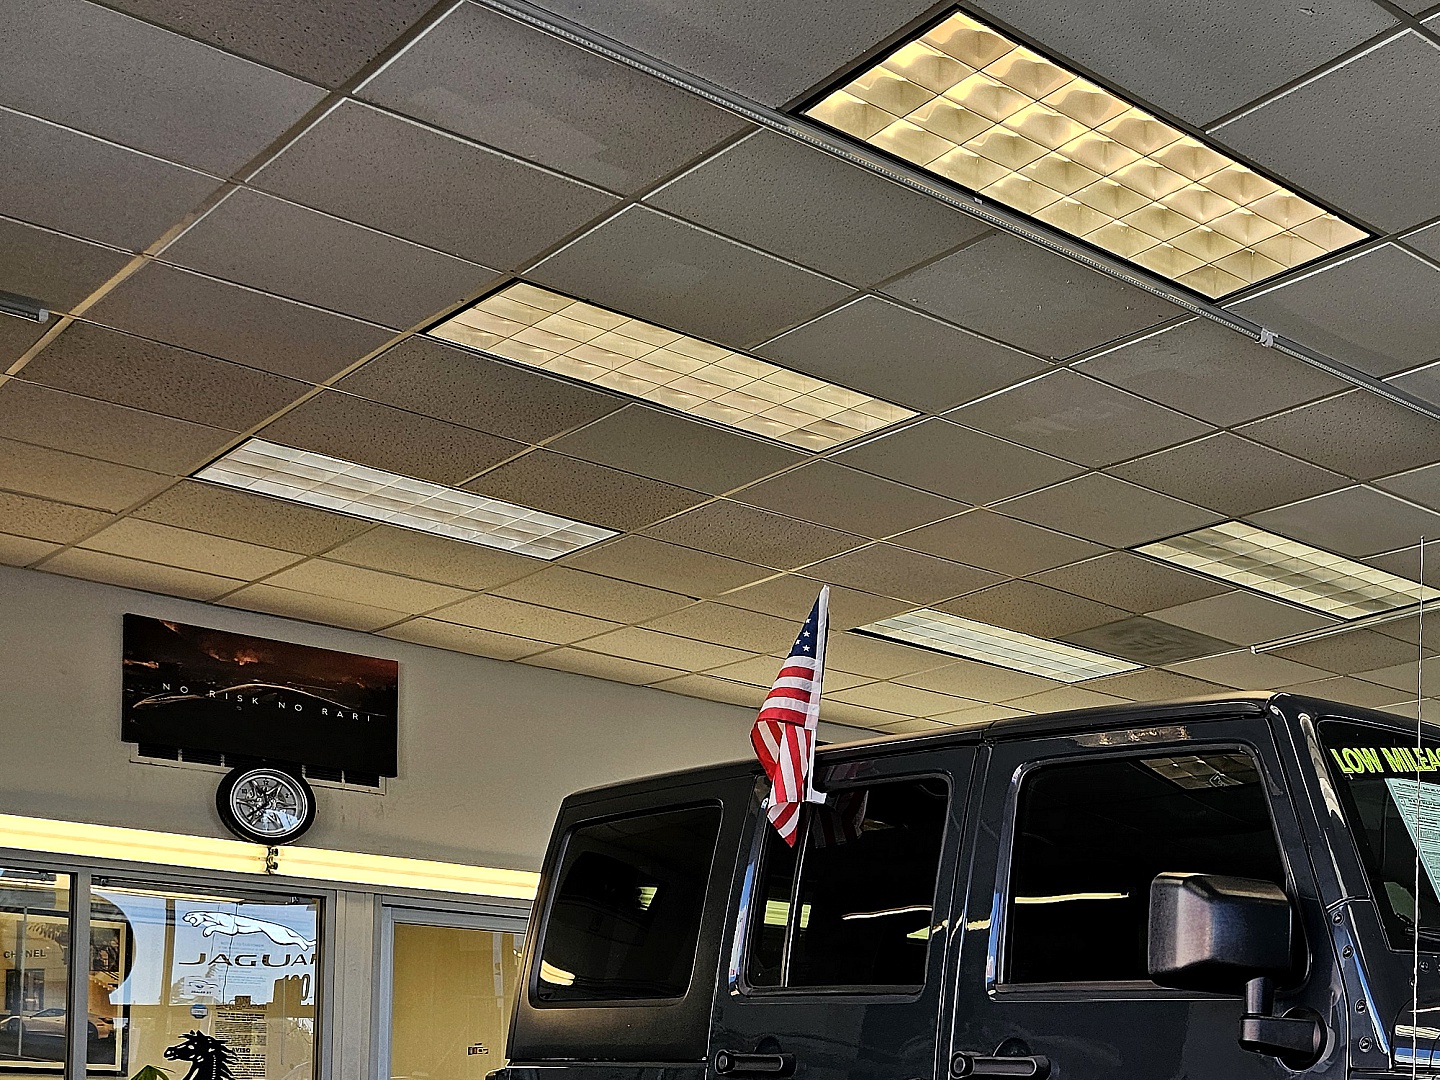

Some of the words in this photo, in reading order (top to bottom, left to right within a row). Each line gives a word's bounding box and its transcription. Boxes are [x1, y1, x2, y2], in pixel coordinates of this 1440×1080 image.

[162, 683, 189, 694] NO
[209, 690, 259, 705] RISK
[278, 701, 303, 712] NO
[321, 708, 371, 722] RARI
[1330, 748, 1384, 773] LOW
[3, 949, 47, 959] CHNEL
